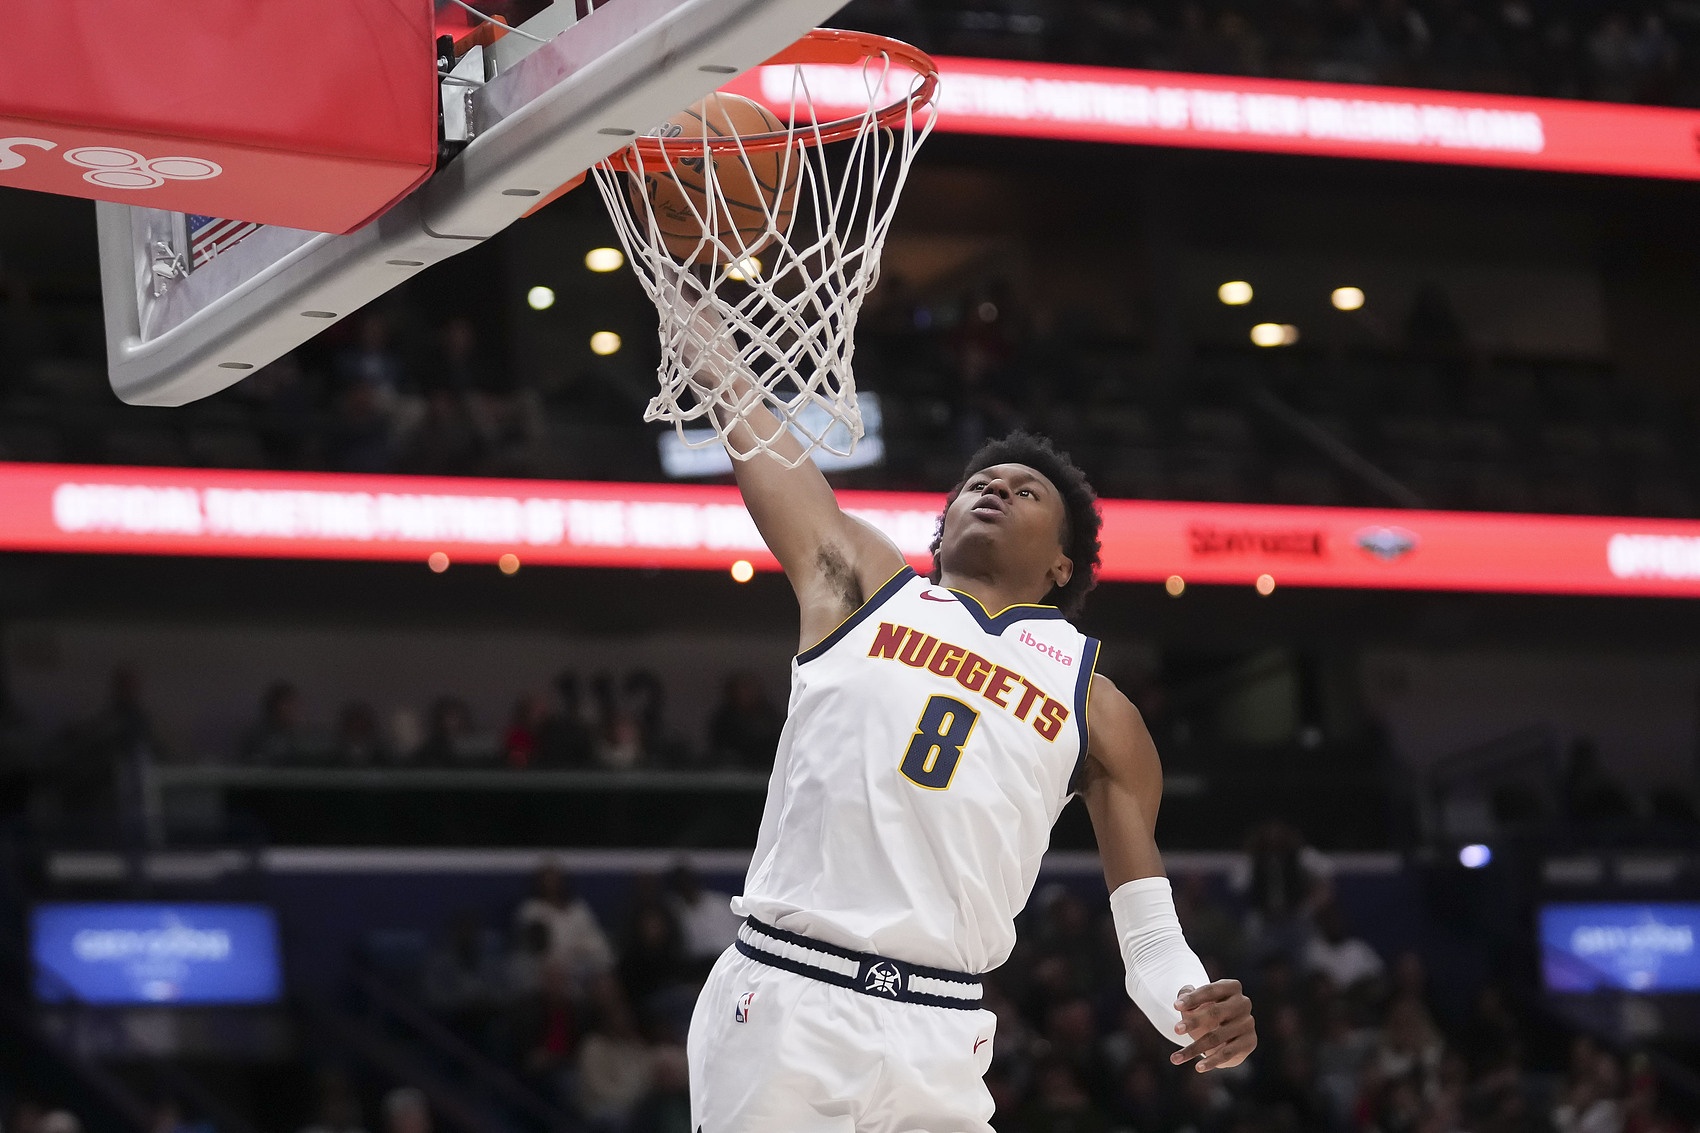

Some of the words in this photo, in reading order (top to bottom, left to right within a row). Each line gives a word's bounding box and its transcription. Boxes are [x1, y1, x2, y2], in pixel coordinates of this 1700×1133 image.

[867, 622, 1071, 743] NUGGETS
[1019, 629, 1072, 666] ibotta
[898, 694, 981, 791] 8
